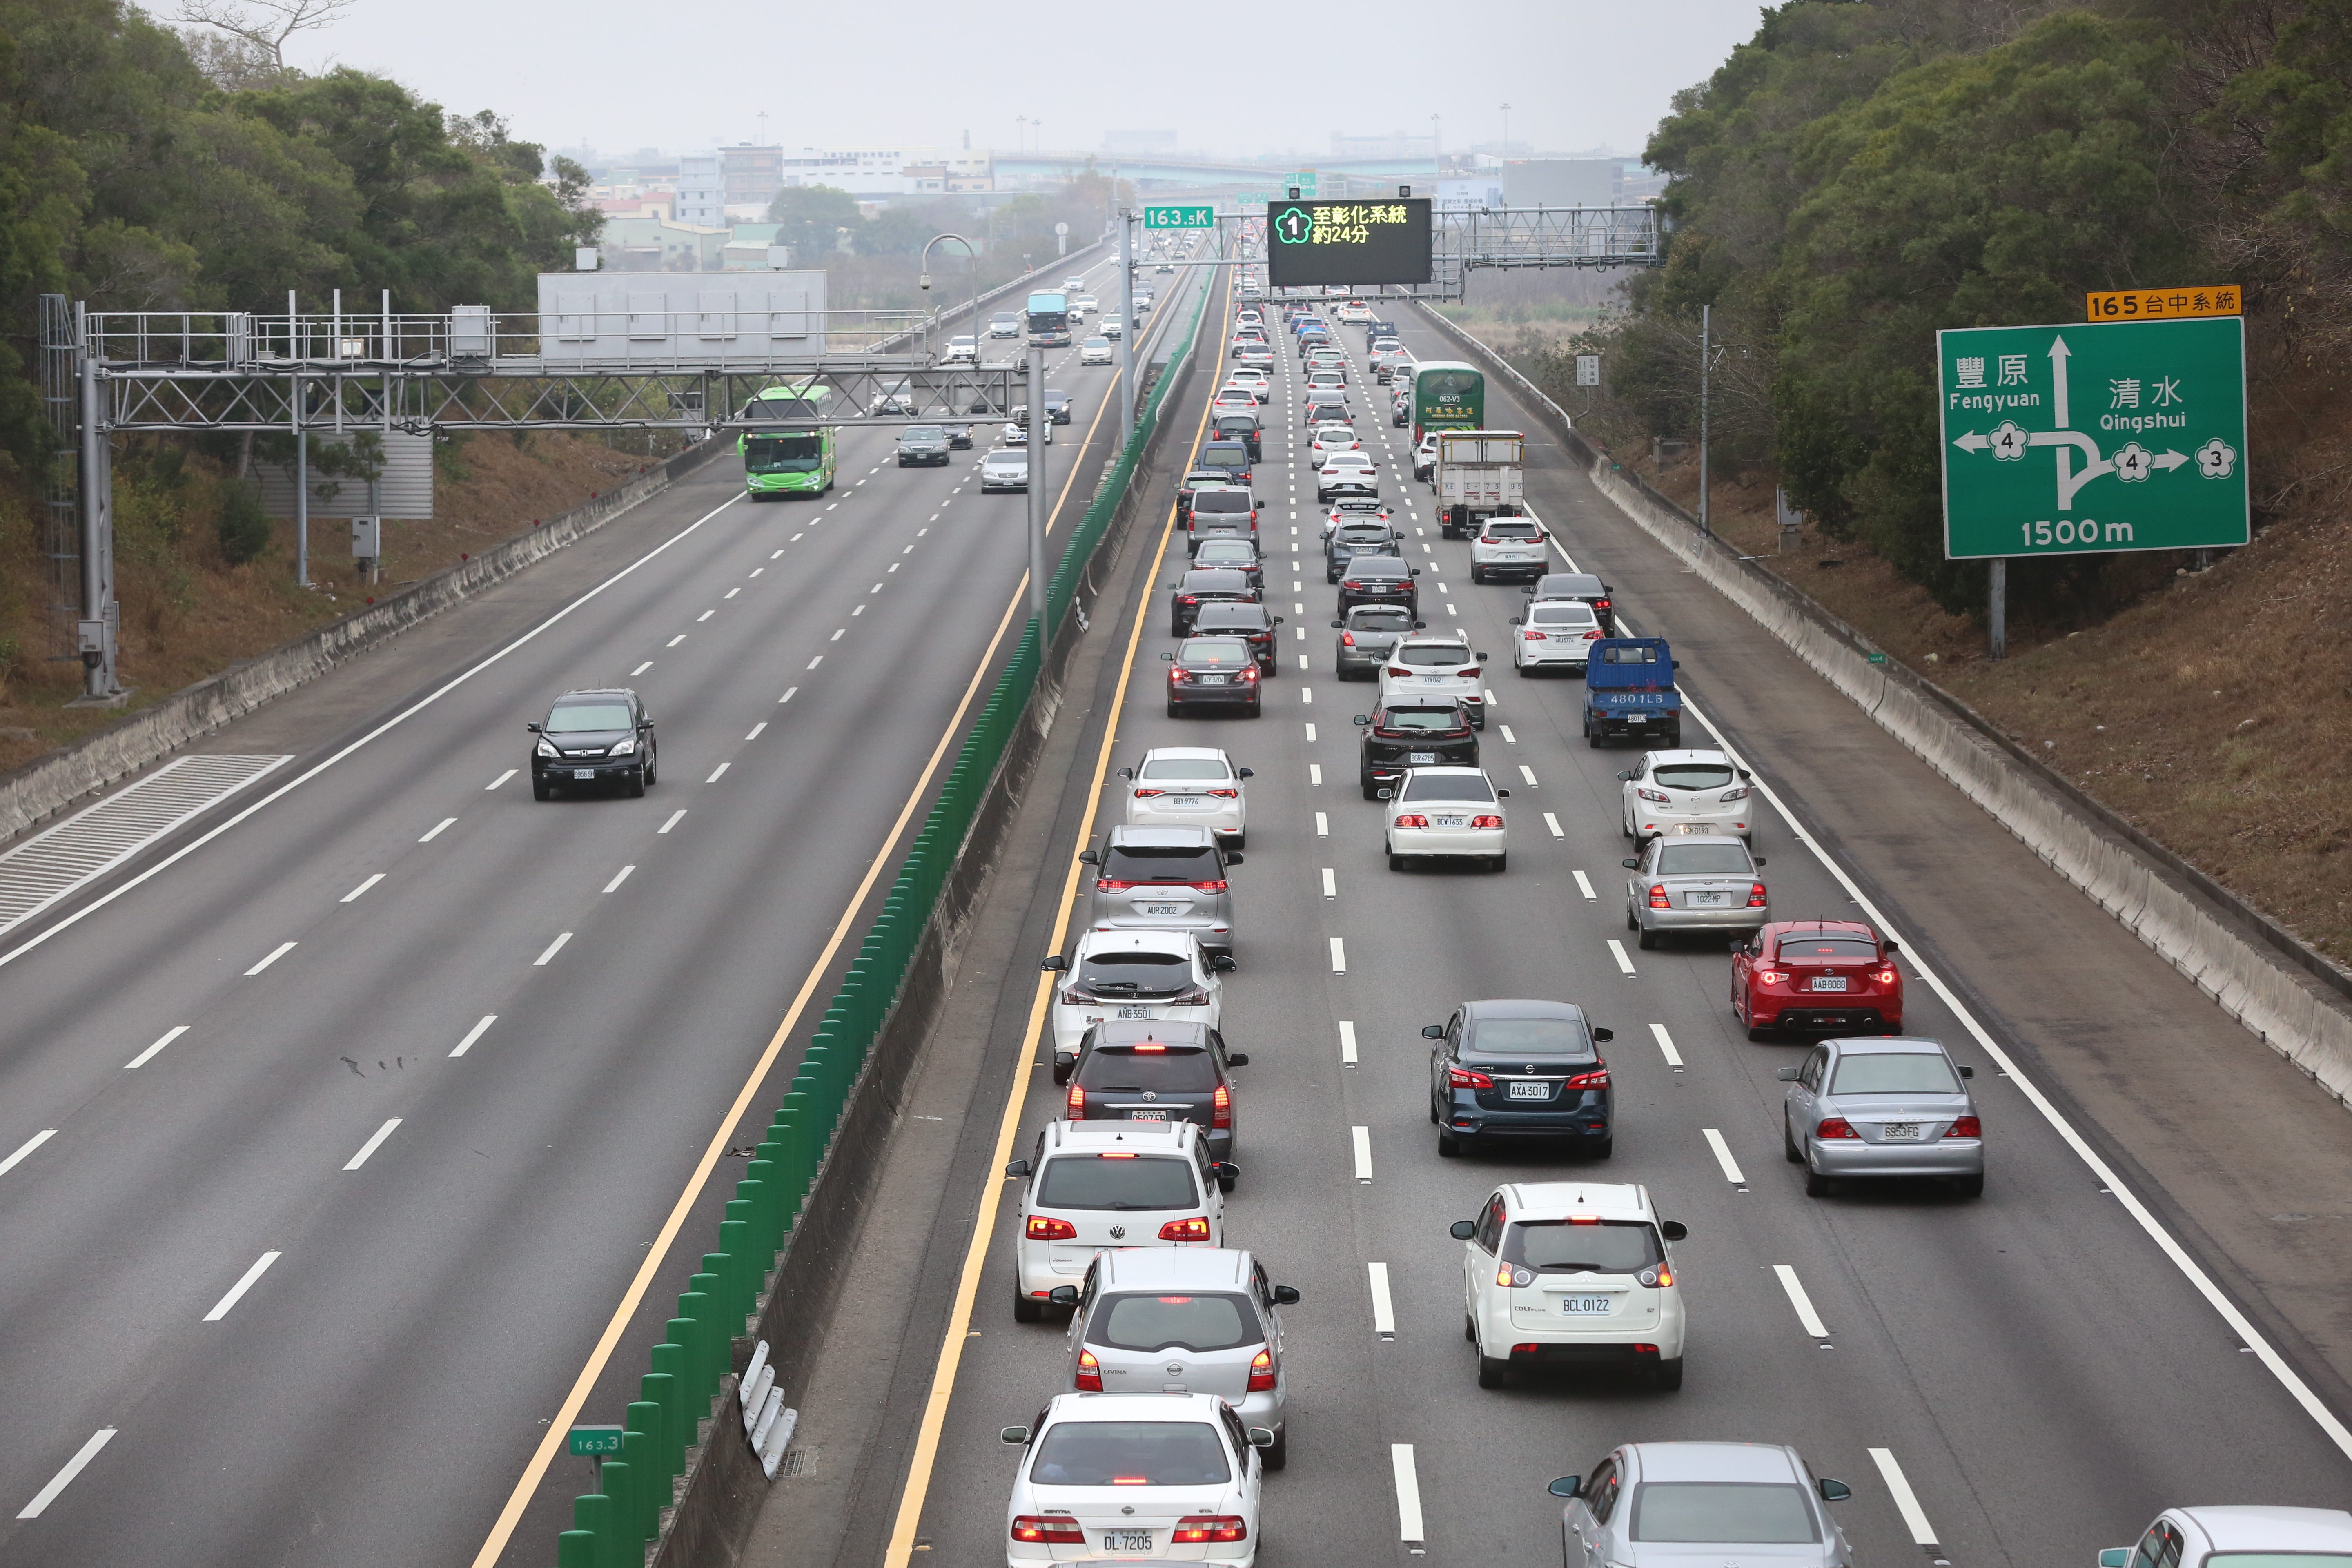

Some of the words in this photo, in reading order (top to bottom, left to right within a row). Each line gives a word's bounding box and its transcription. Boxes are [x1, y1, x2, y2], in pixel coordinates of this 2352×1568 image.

[1149, 209, 1208, 225] 163.5K
[1312, 205, 1407, 225] 至彰化系統
[1312, 225, 1369, 245] 約24分
[2093, 296, 2138, 316] 165
[2145, 291, 2234, 314] 台中系統
[1956, 354, 2029, 389] 豐原
[1950, 392, 2040, 413] Fengyuan
[2109, 376, 2183, 409] 清水
[2100, 412, 2185, 434] Qingshui
[2001, 433, 2013, 449] 4
[2126, 454, 2138, 470] 4
[2210, 451, 2222, 467] 3
[2022, 519, 2098, 546] 1500
[2105, 521, 2134, 542] m
[579, 1437, 618, 1450] 163.3
